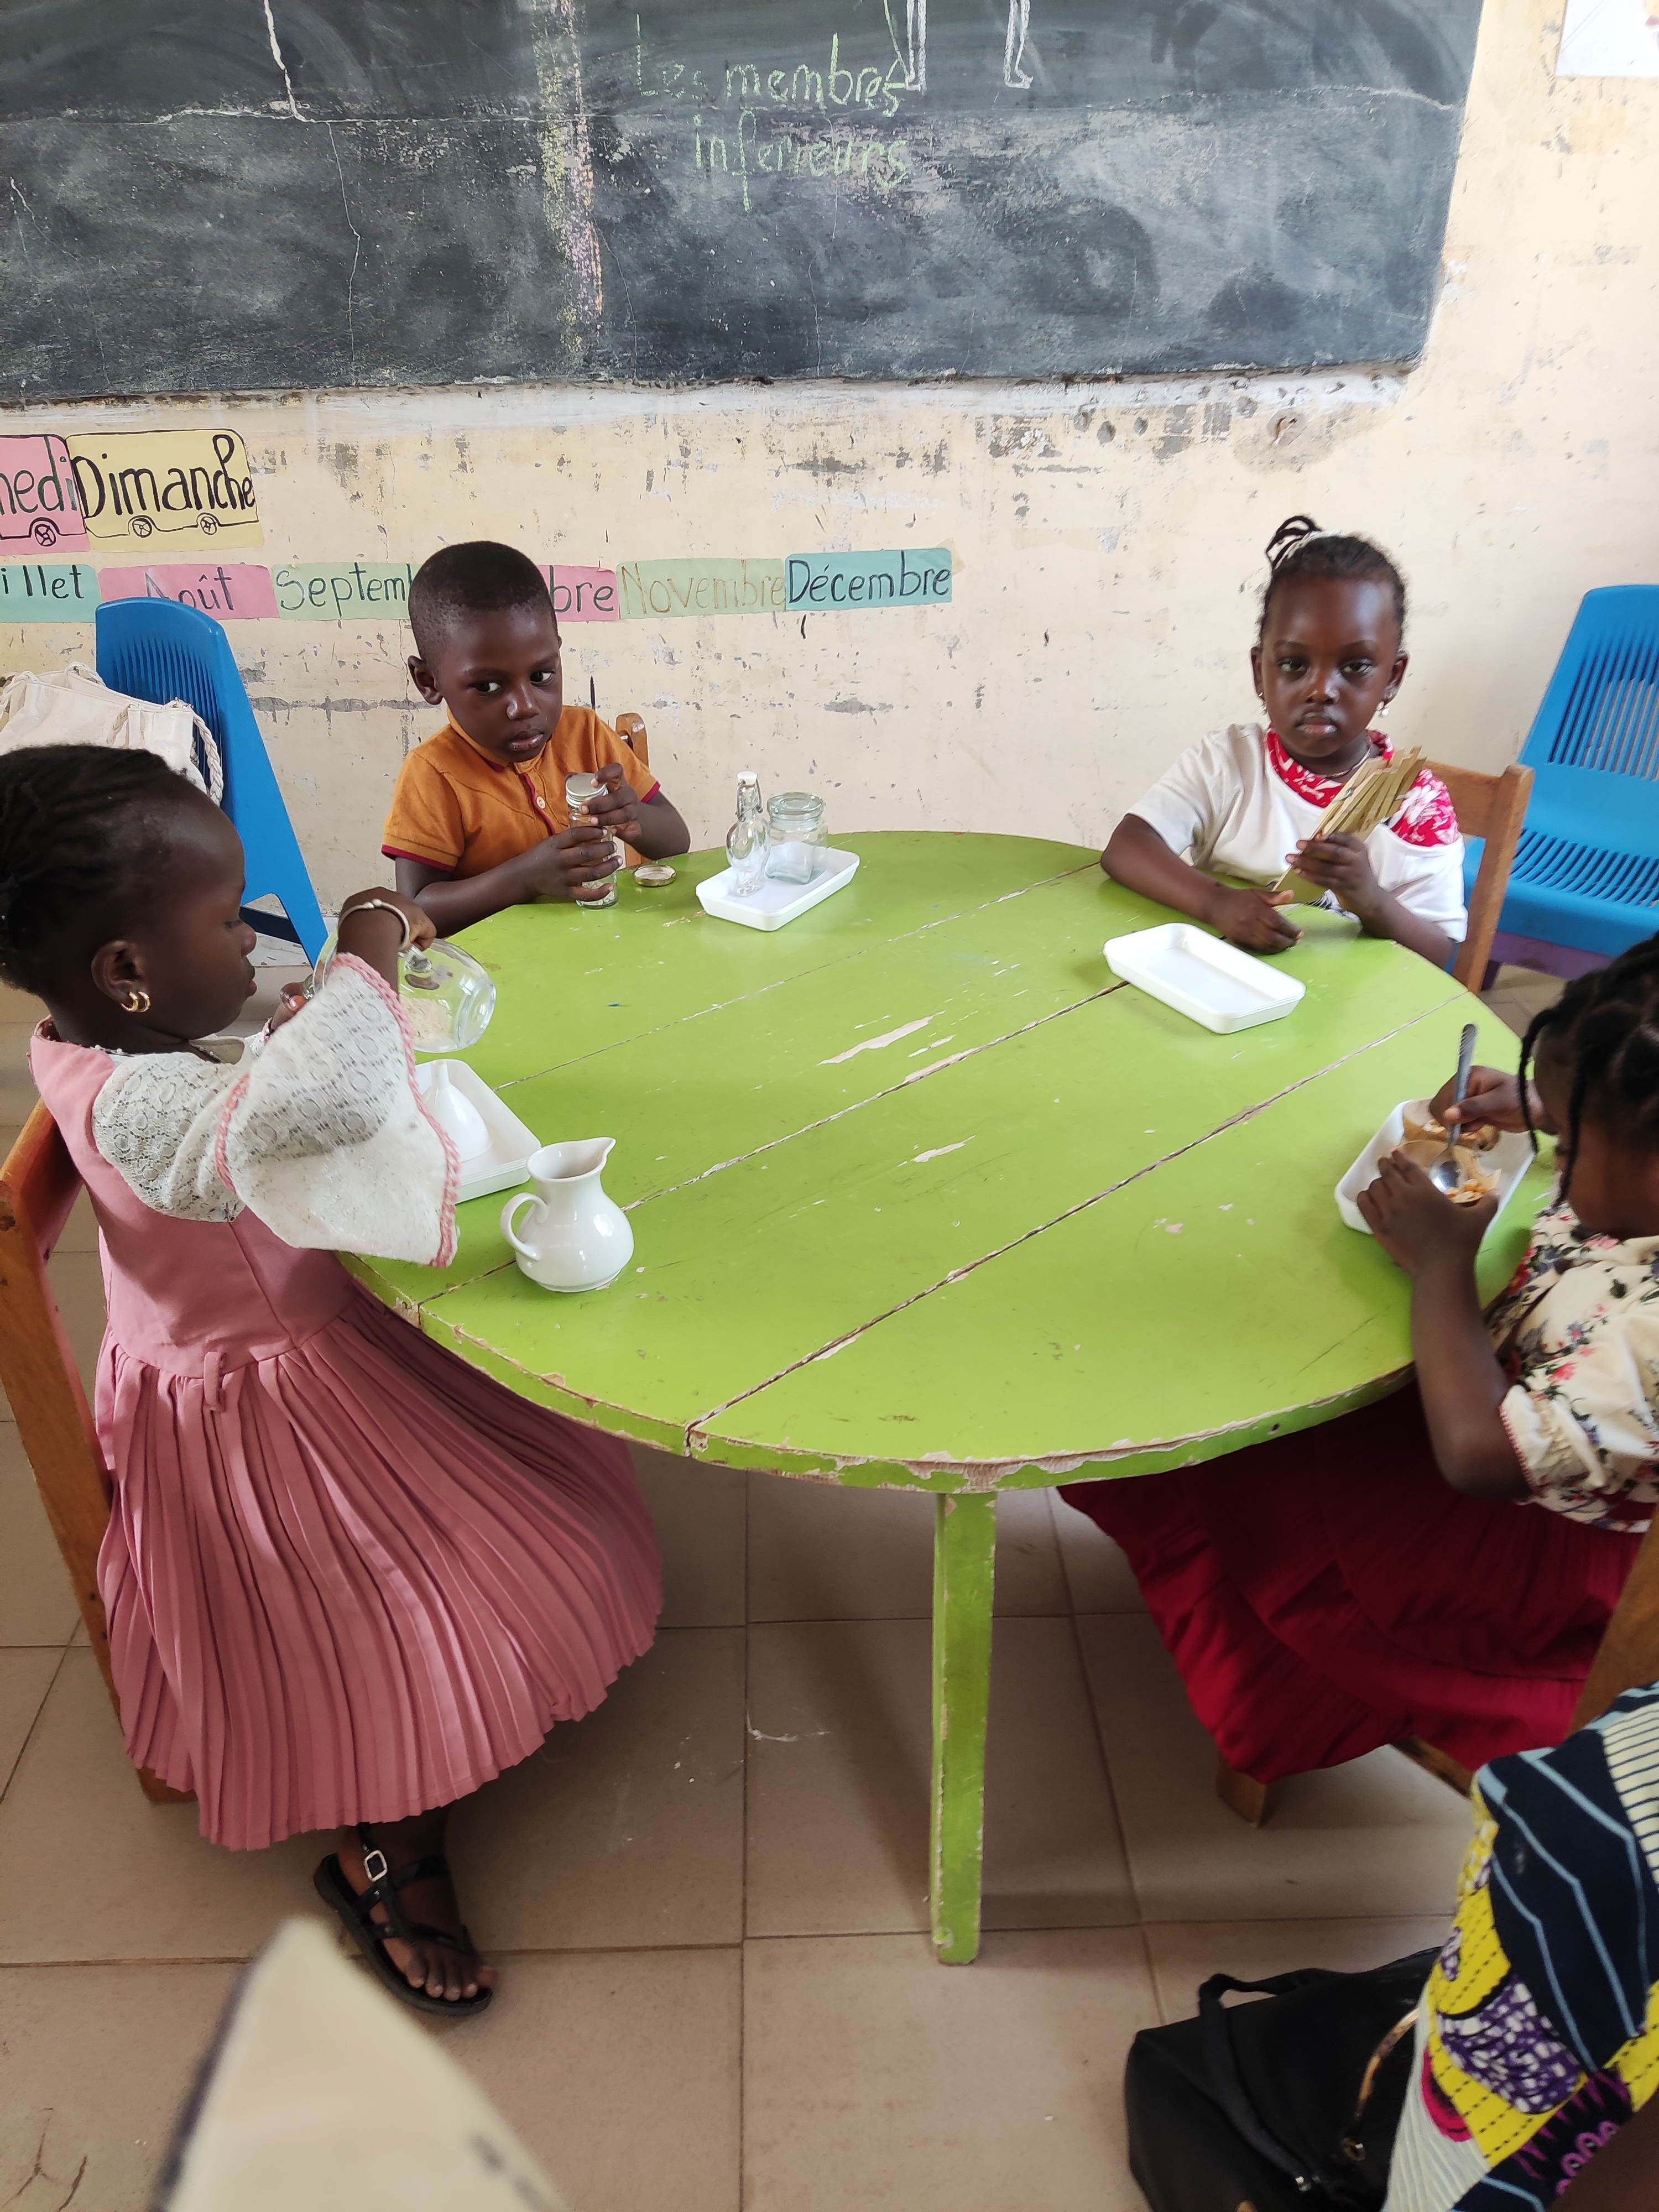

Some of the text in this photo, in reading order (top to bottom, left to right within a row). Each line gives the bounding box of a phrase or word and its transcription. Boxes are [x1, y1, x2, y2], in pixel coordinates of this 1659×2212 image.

[636, 13, 905, 117] Les membres
[71, 435, 255, 518] Dimanche
[0, 565, 84, 599] illet
[621, 560, 785, 614] Novembre
[788, 550, 951, 604] Décembre
